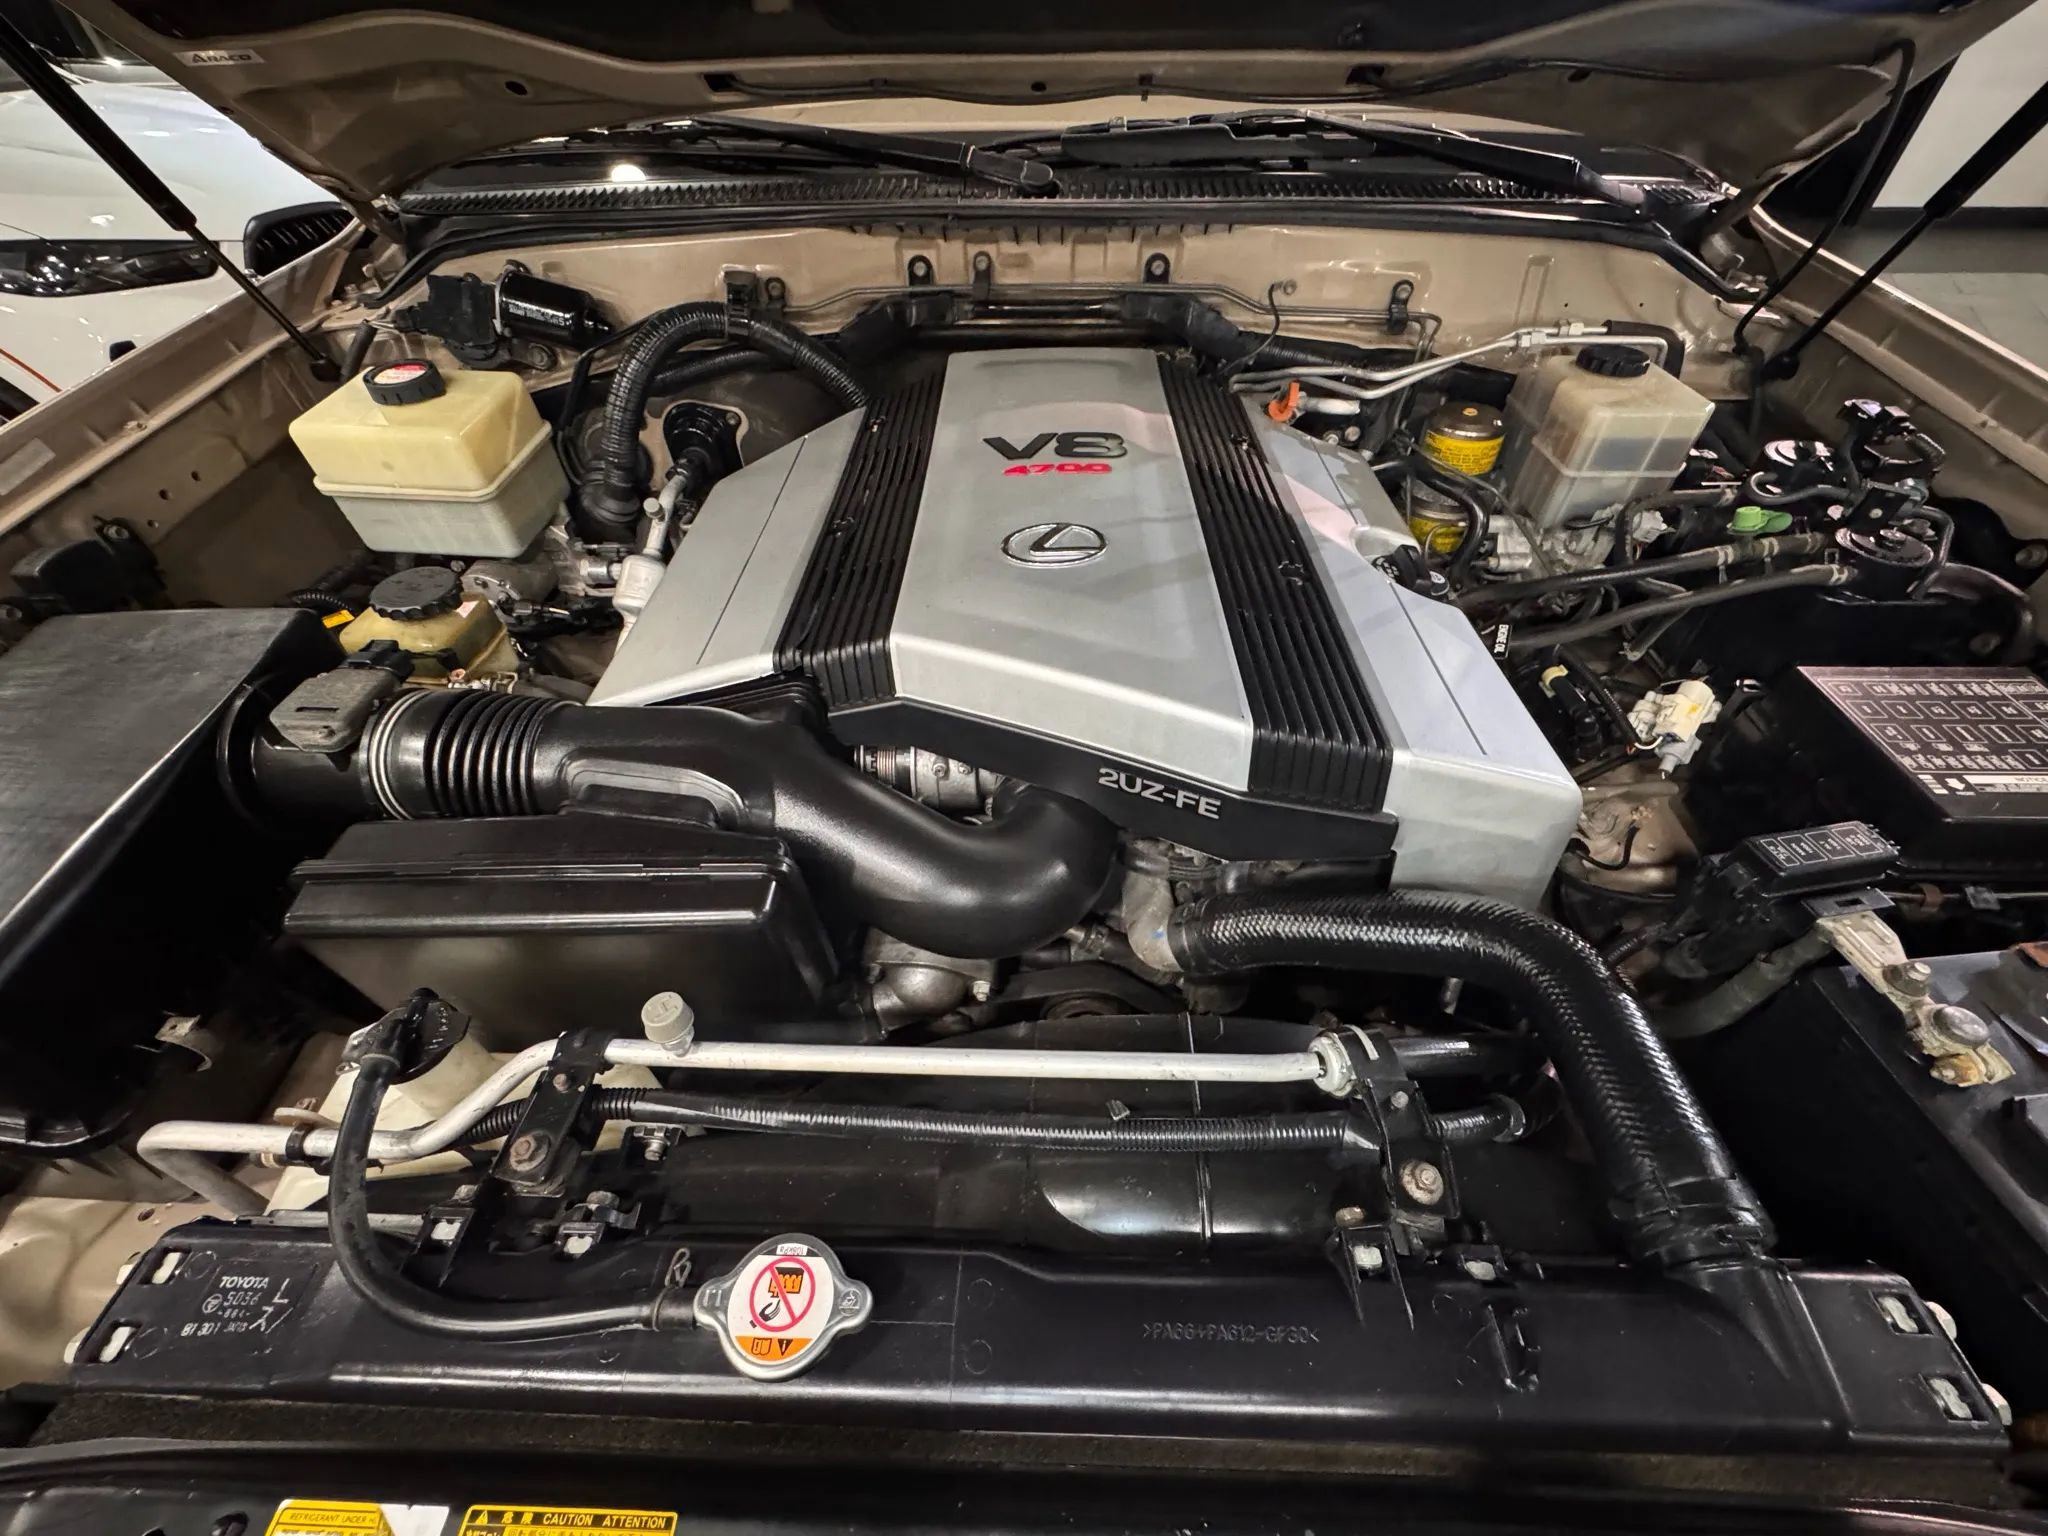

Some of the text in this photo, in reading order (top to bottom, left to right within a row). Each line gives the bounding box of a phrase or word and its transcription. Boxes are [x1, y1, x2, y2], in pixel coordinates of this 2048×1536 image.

[982, 432, 1128, 460] V8
[1003, 463, 1113, 476] 4700
[1098, 767, 1221, 820] 2UZ-FE
[219, 1276, 270, 1289] TOYOTA
[543, 1513, 594, 1526] CAUTION
[602, 1515, 666, 1529] ATTENTION
